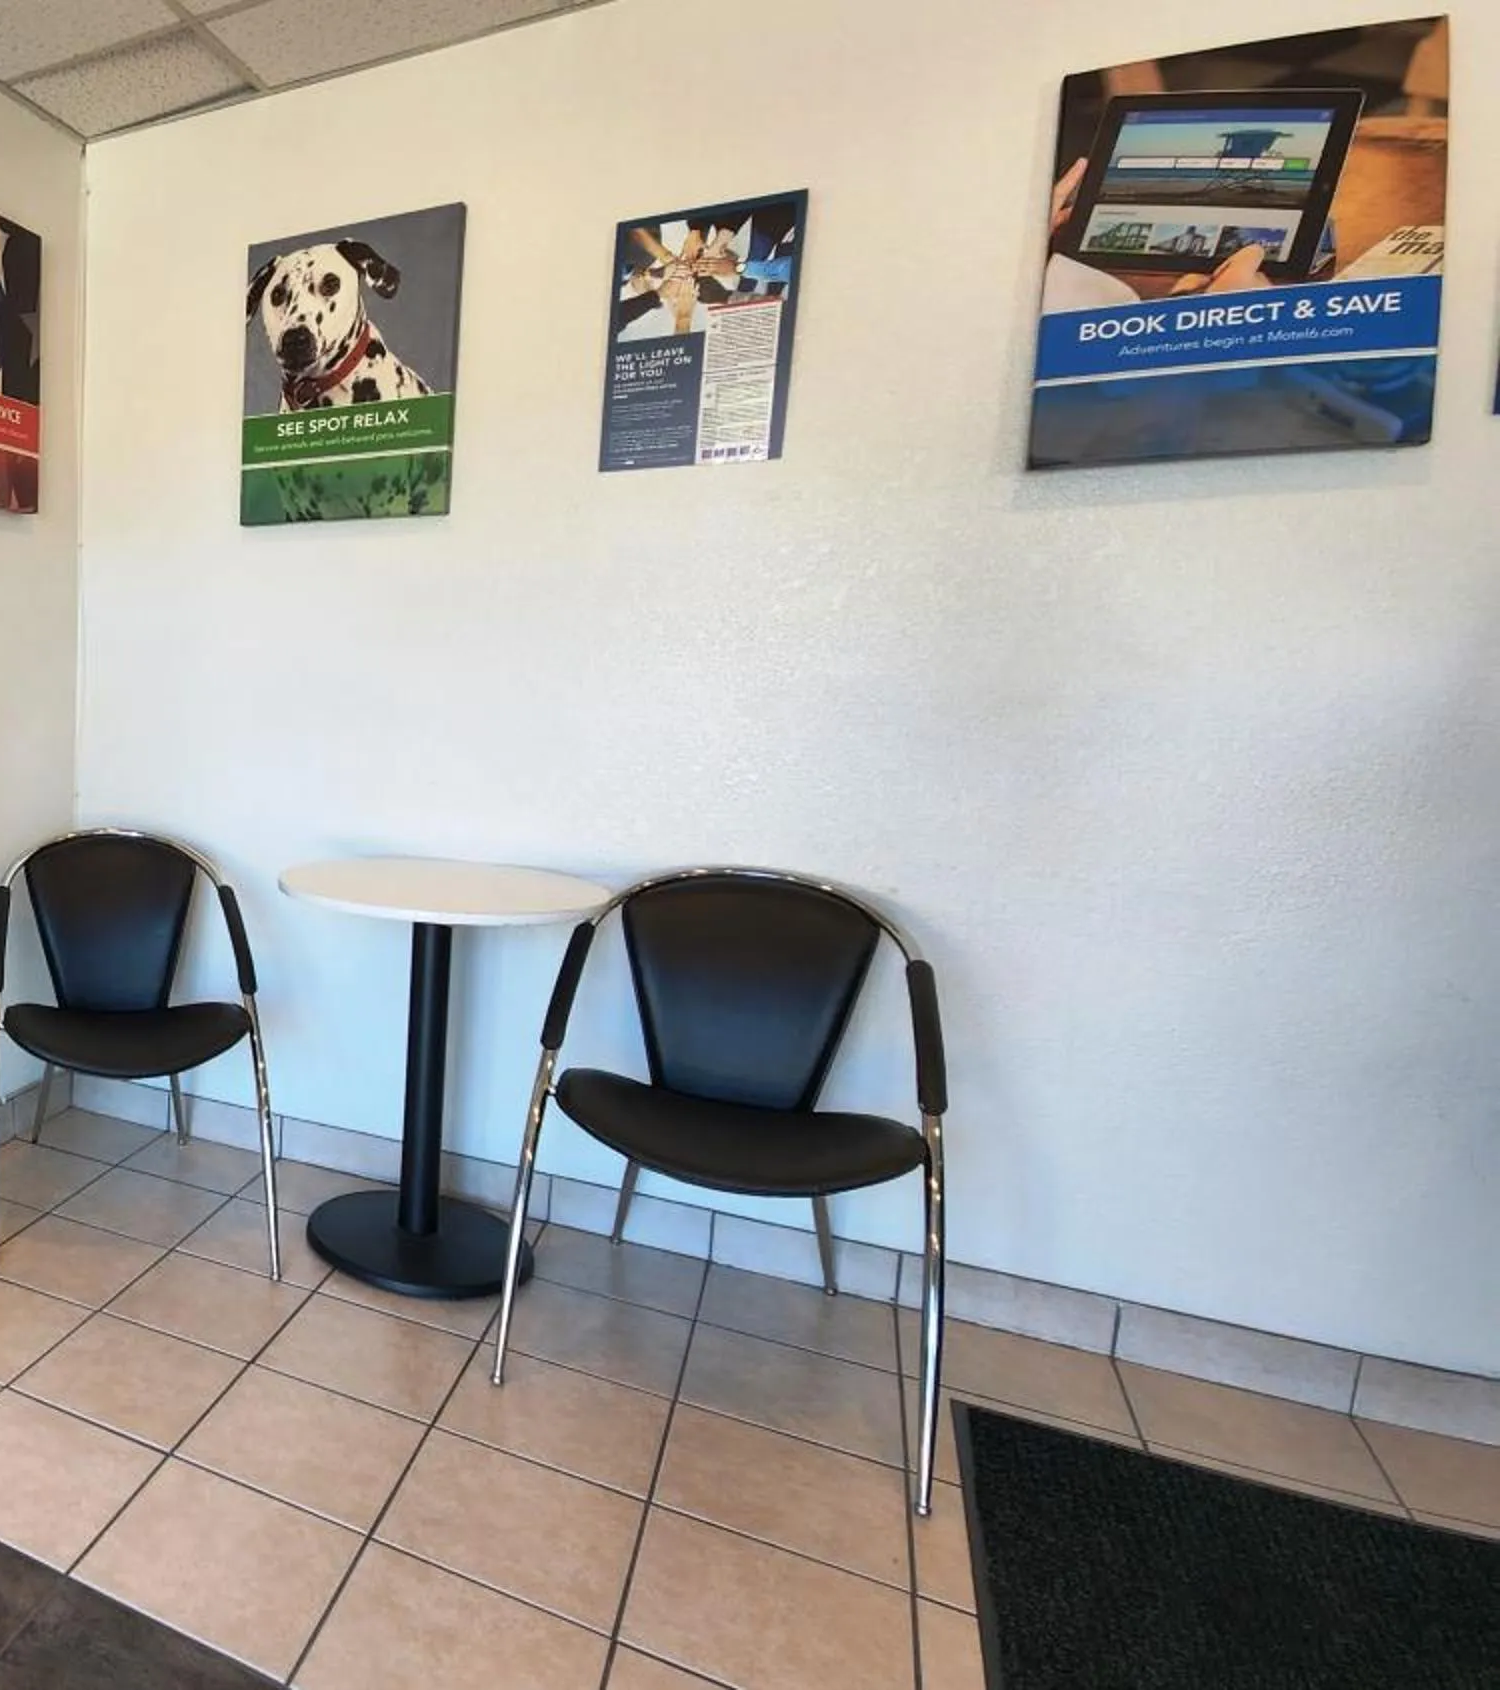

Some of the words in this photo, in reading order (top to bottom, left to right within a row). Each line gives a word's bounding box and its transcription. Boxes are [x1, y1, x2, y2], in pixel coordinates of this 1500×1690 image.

[1078, 313, 1166, 342] BOOK
[1175, 301, 1285, 331] DIRECT
[1293, 298, 1315, 319] &
[1326, 291, 1402, 317] SAVE
[651, 346, 685, 359] LEAVE
[1118, 340, 1200, 357] Adventures
[1203, 335, 1245, 350] begin
[1247, 333, 1263, 344] at
[1267, 326, 1354, 342] Motel6.com
[615, 361, 636, 371] THE
[639, 358, 670, 369] LIGHT
[673, 355, 692, 366] ON
[614, 371, 637, 381] FOR
[276, 421, 305, 438] SEE
[308, 415, 350, 434] SPOT
[353, 408, 410, 429] RELAX
